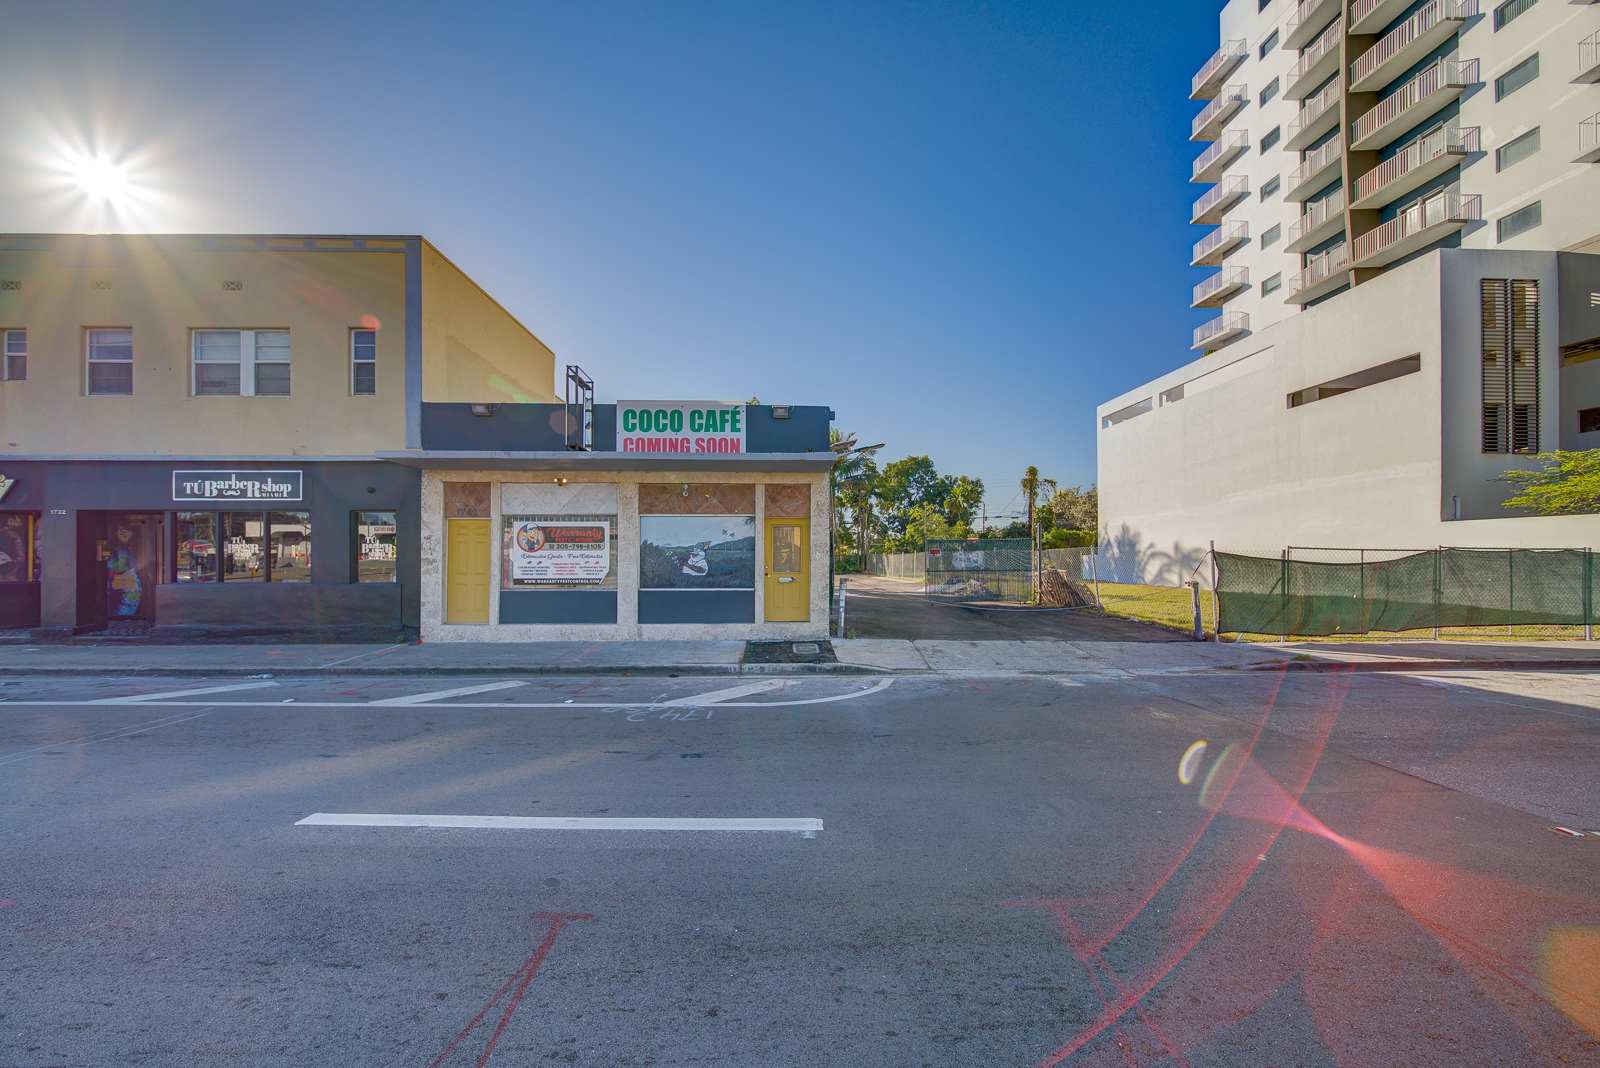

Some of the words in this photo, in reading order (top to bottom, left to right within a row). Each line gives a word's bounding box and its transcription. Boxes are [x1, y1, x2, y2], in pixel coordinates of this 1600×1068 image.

[623, 409, 684, 433] COCO
[689, 405, 741, 433] CAFÉ
[623, 437, 691, 453] COMING
[695, 437, 741, 453] SOON
[183, 480, 204, 494] TÚ
[261, 478, 292, 497] shop
[546, 527, 602, 540] Warranty
